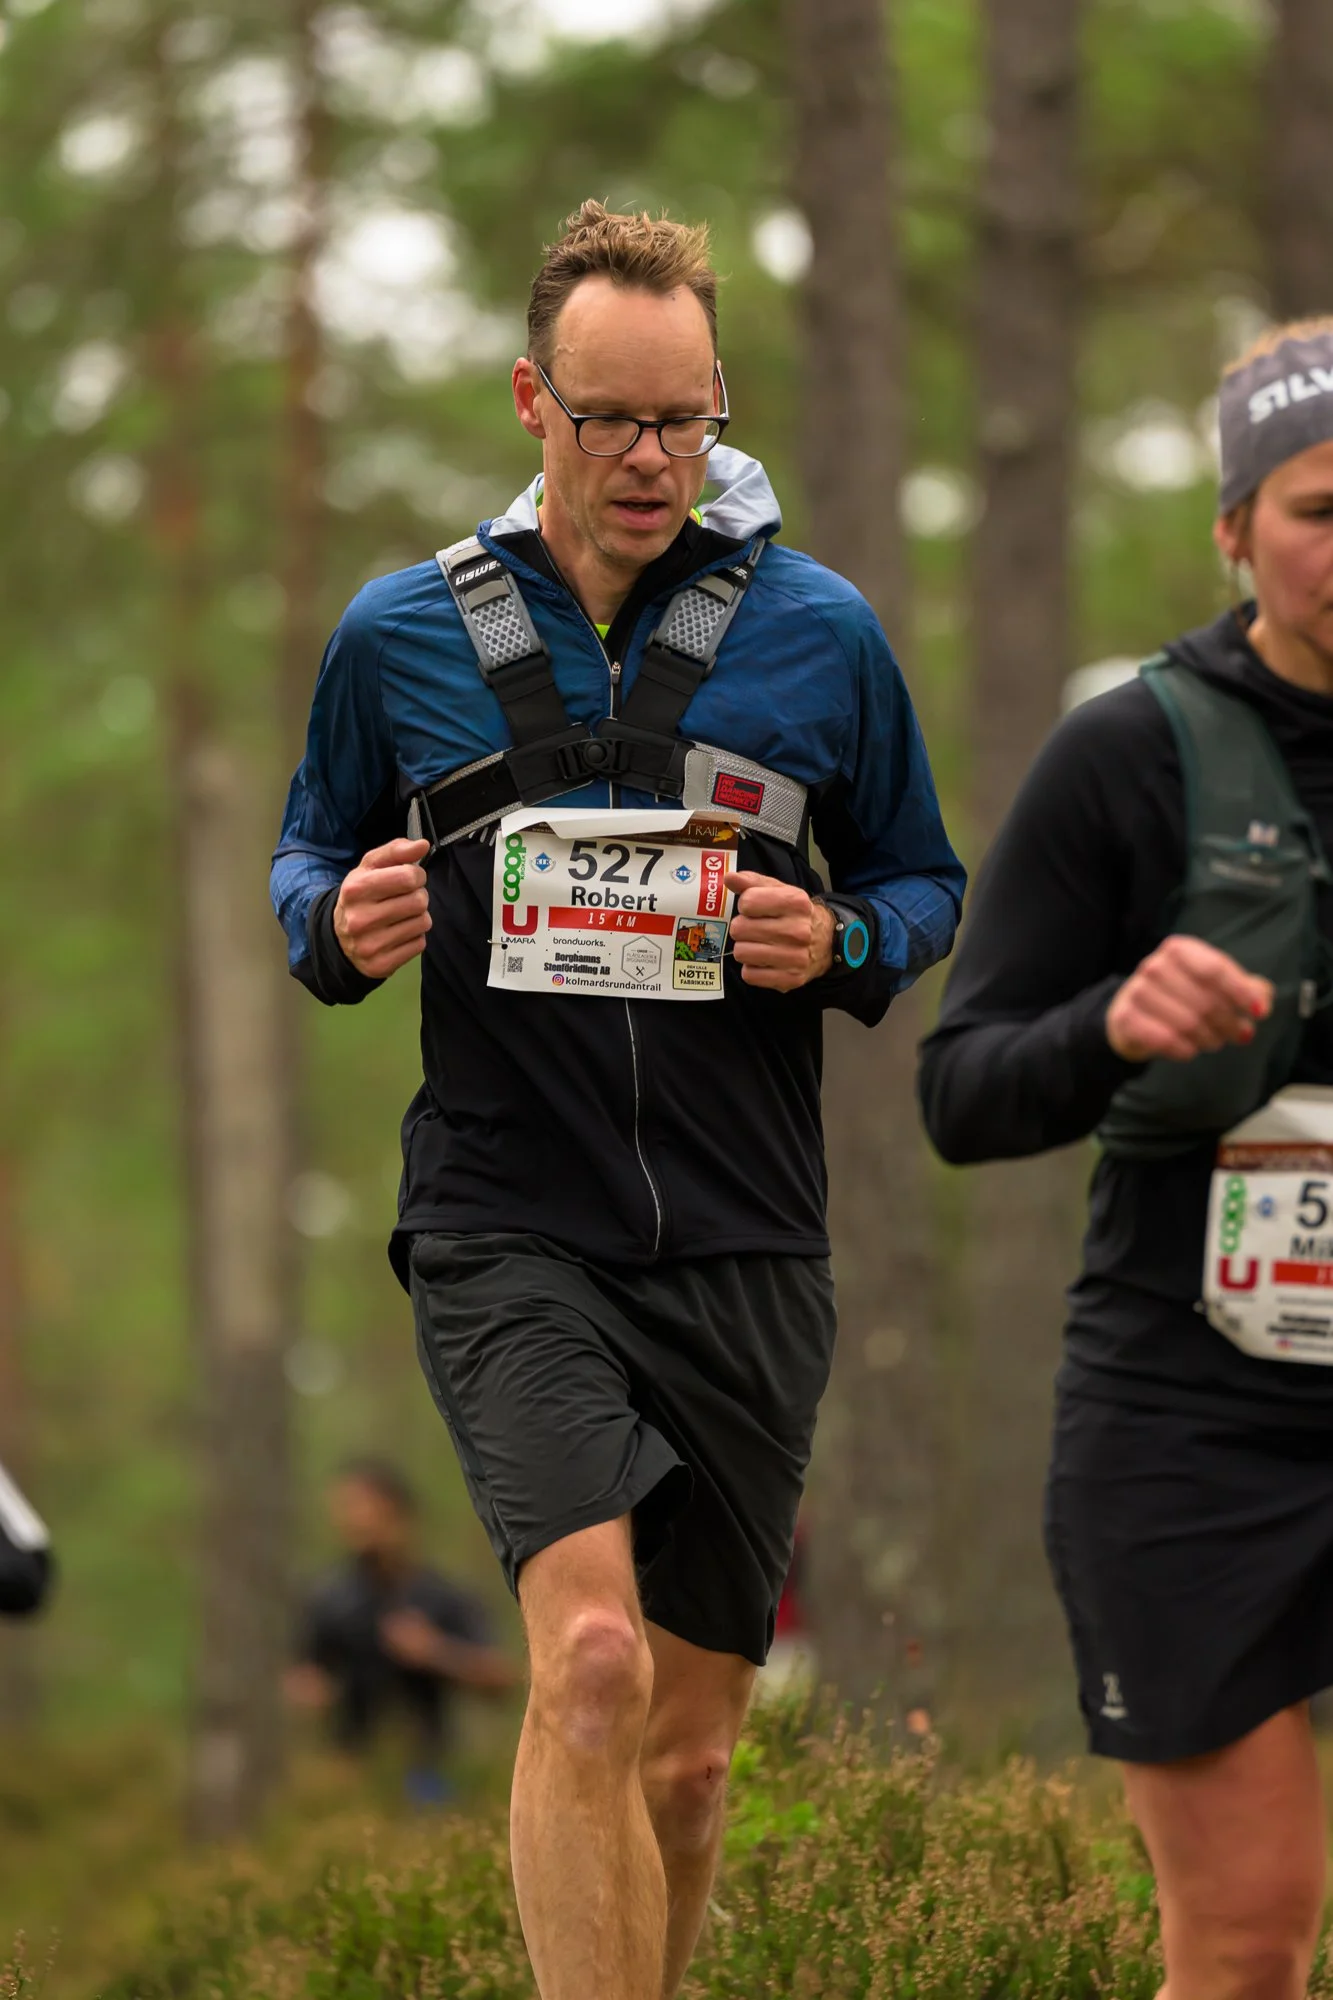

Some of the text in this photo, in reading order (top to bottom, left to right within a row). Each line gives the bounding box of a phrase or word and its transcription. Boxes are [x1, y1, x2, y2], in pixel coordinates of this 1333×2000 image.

[503, 833, 526, 902] coop
[568, 840, 664, 886] 527
[705, 871, 719, 911] CIRCLE
[571, 886, 657, 912] Robert
[587, 912, 636, 928] 15 KM
[501, 936, 536, 945] UMARA
[552, 937, 606, 947] brandworks.
[600, 966, 611, 975] AB
[678, 969, 716, 980] NØTTE
[565, 977, 661, 991] kolmardsrundantrail
